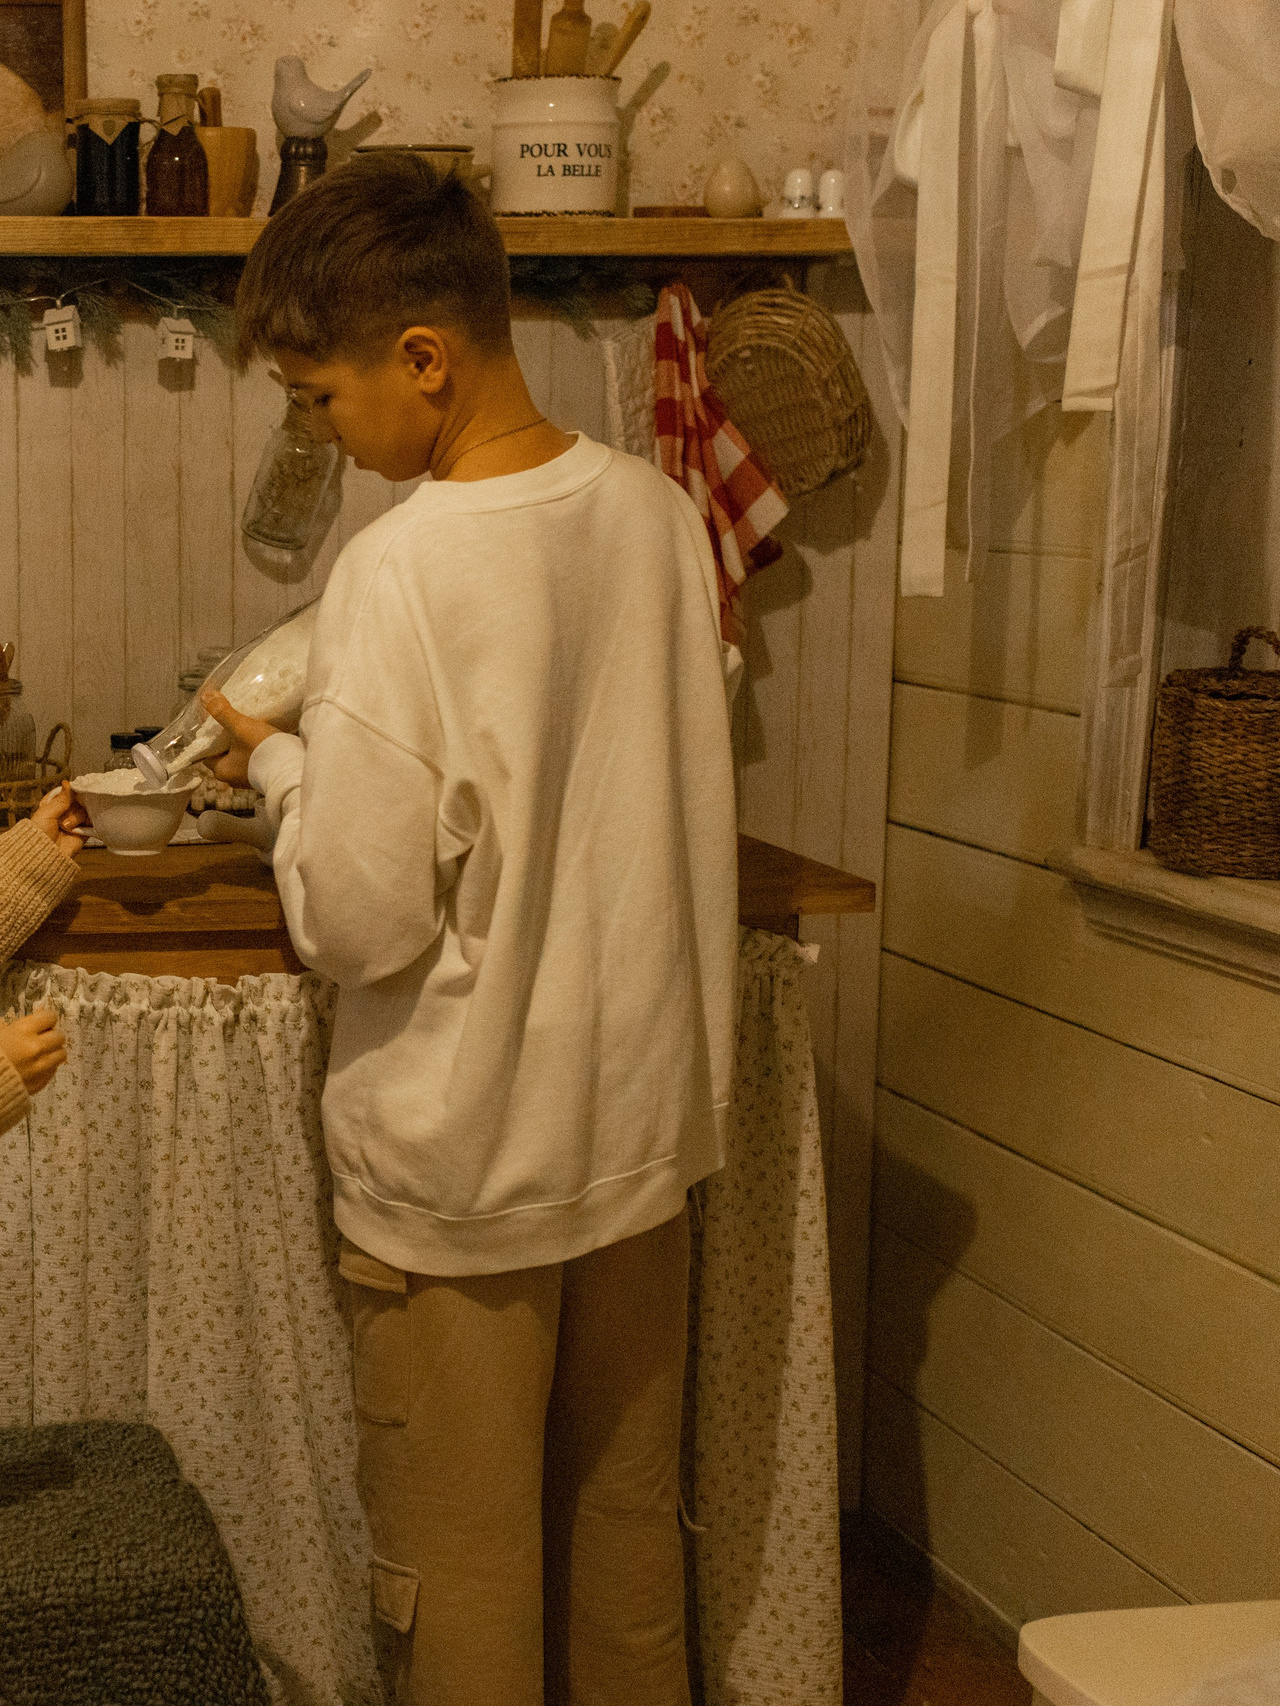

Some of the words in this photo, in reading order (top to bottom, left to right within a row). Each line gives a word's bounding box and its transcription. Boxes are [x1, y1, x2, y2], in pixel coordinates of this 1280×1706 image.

[520, 143, 568, 158] POUR
[536, 164, 556, 177] LA
[562, 164, 601, 177] BELLE
